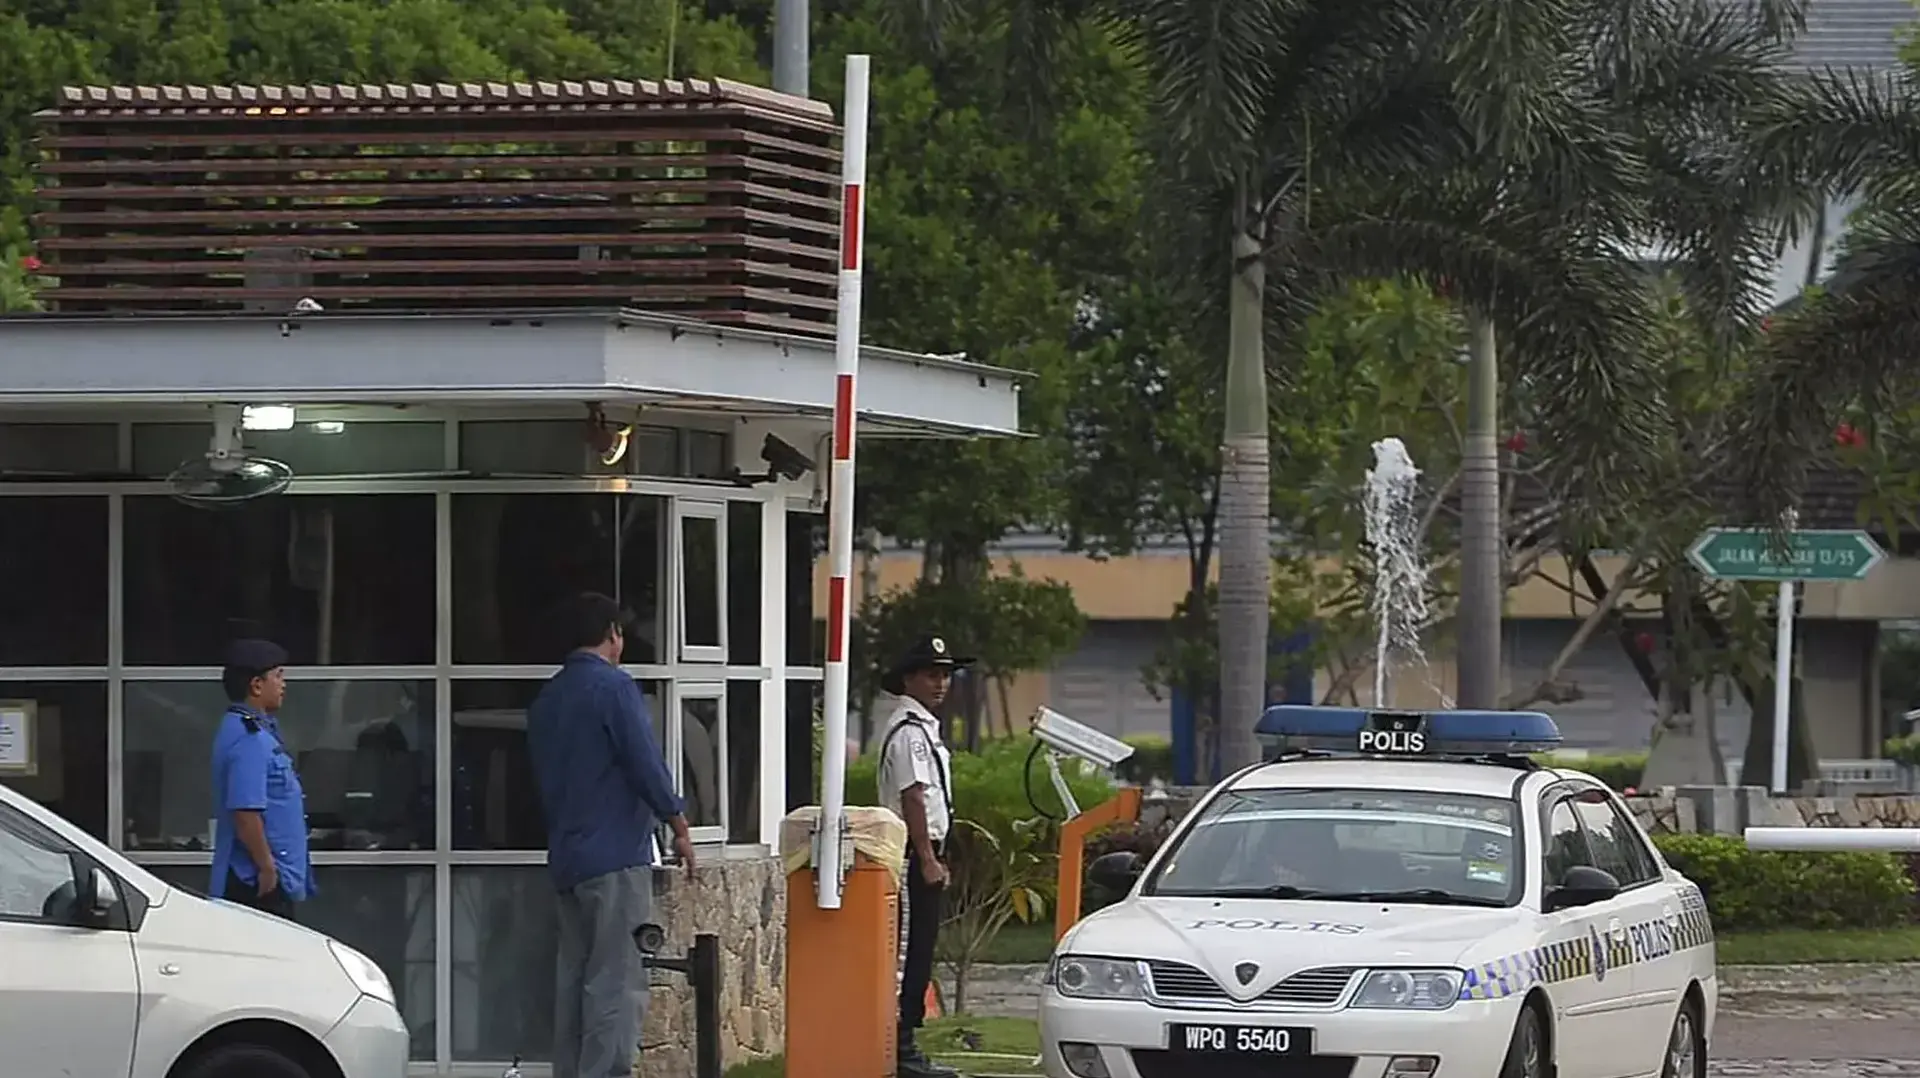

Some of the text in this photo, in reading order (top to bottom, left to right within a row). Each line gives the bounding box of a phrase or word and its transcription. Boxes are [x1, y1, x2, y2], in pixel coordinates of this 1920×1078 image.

[1718, 548, 1755, 564] JALAN
[1360, 731, 1424, 752] POLIS
[1185, 919, 1366, 935] POLIS
[1629, 919, 1671, 962] POLIS
[1185, 1026, 1290, 1052] WPQ 5540
